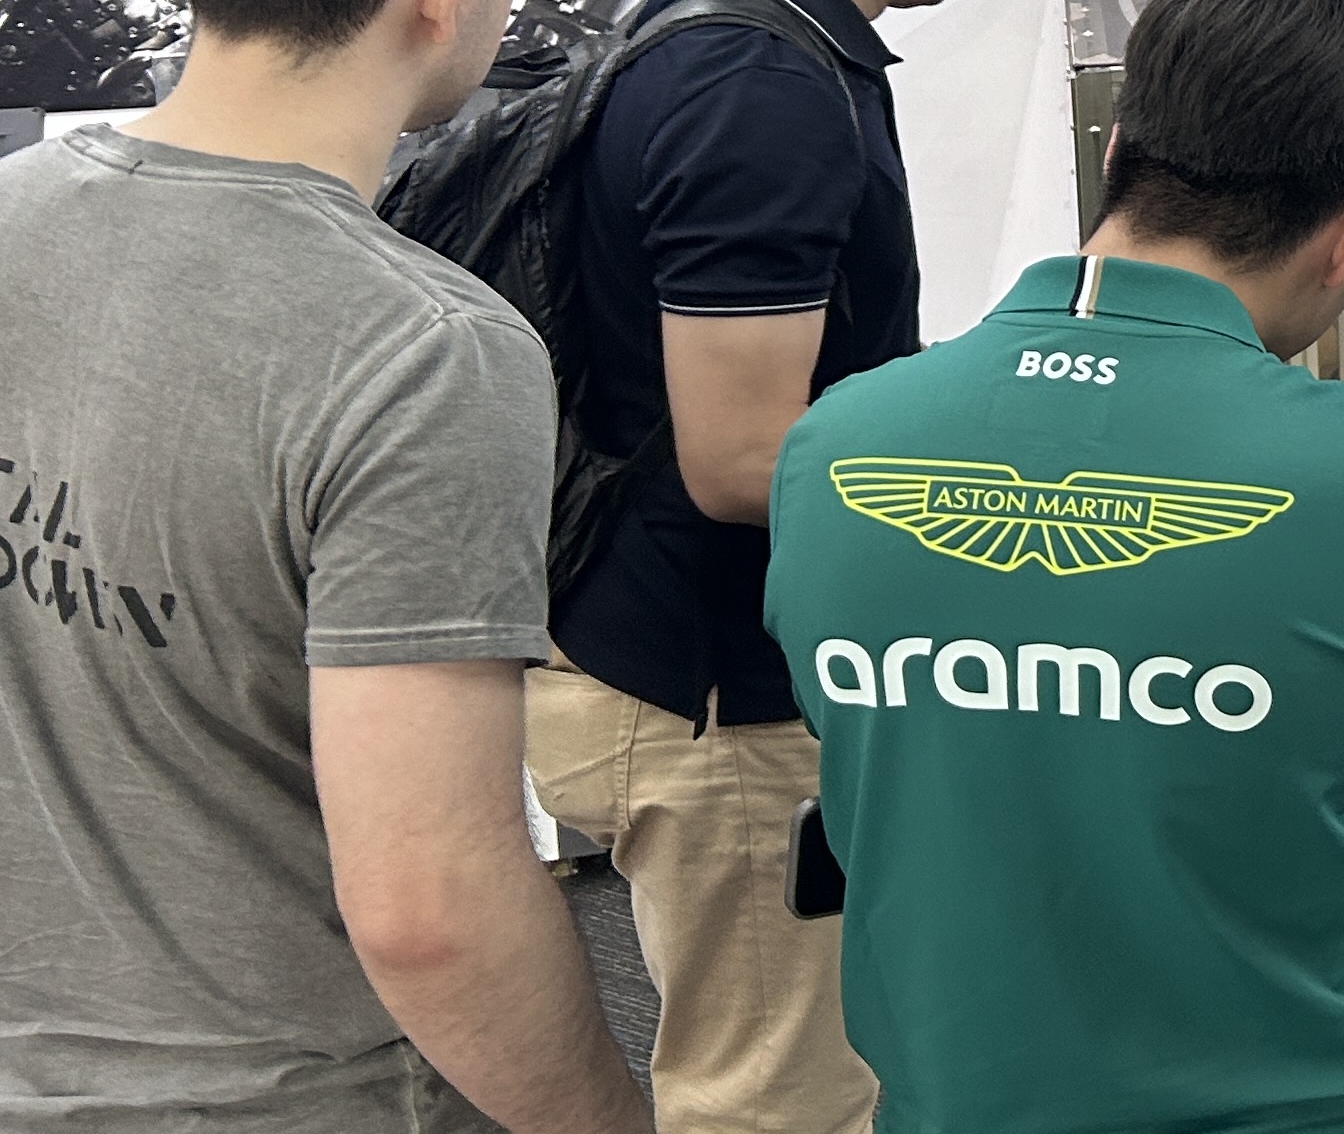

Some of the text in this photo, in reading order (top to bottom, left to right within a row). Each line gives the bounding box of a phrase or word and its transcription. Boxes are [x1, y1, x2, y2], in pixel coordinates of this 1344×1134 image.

[1015, 350, 1120, 386] BOSS
[932, 485, 1144, 524] ASTON MARTIN
[815, 637, 1273, 732] aramco
